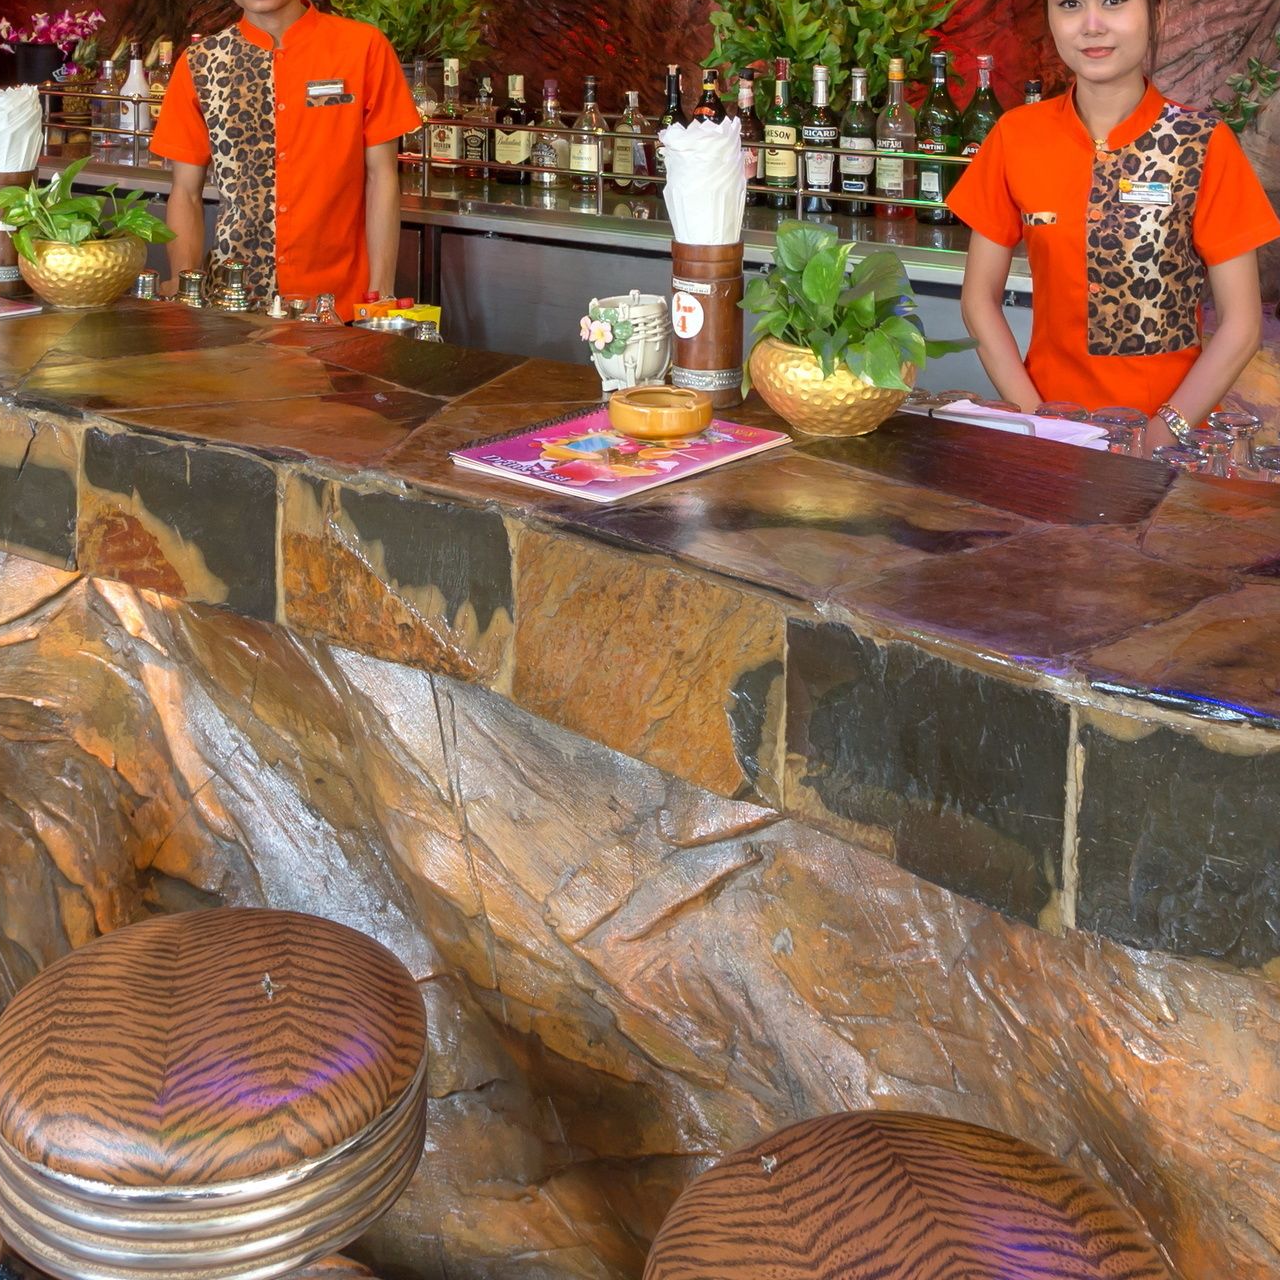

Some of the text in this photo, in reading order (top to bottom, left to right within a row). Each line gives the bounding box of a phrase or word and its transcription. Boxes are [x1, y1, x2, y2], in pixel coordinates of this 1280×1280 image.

[804, 129, 836, 137] RICARD
[876, 140, 902, 148] CAMPARI
[918, 143, 945, 151] MARTINI
